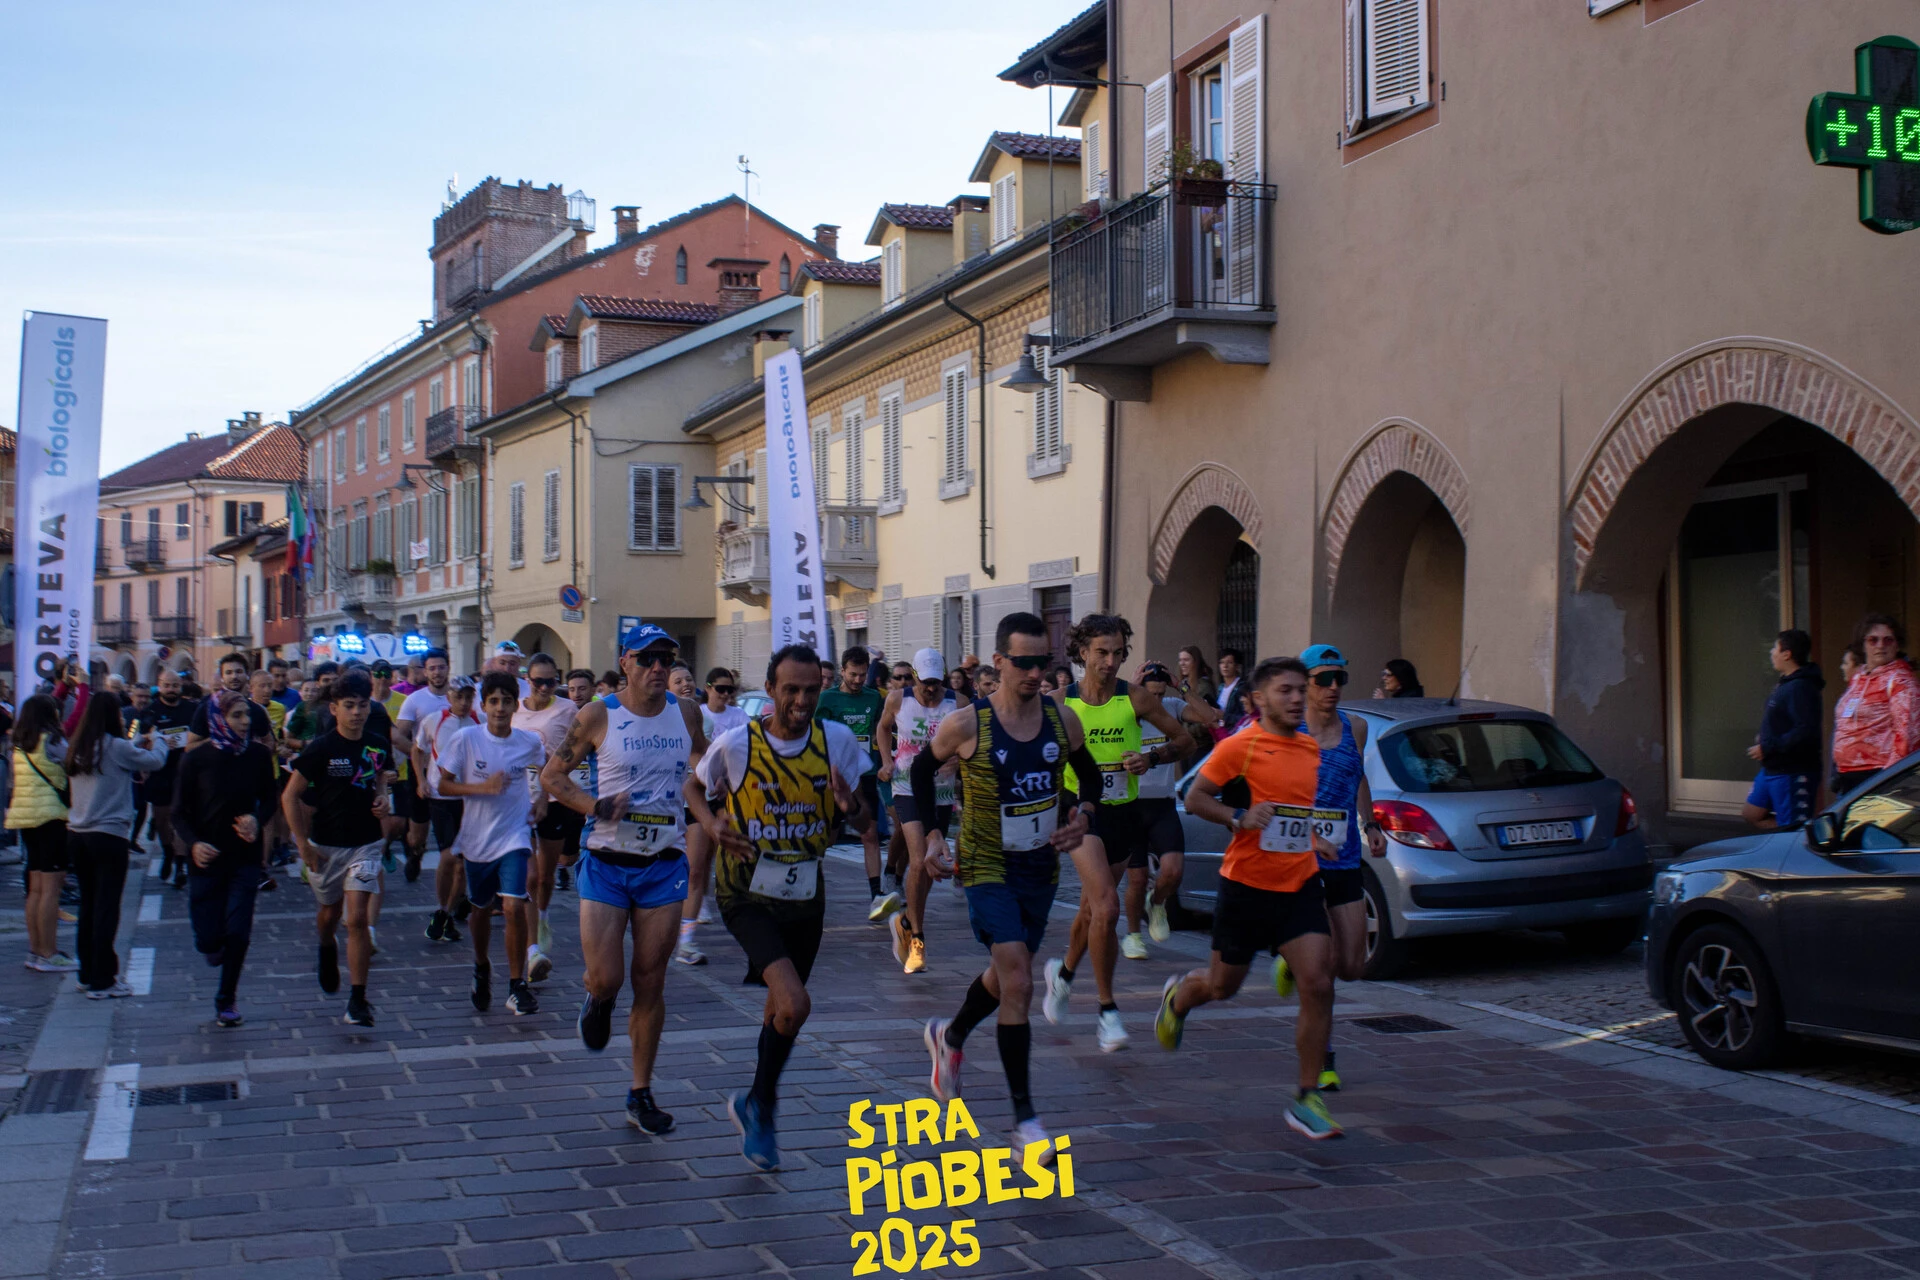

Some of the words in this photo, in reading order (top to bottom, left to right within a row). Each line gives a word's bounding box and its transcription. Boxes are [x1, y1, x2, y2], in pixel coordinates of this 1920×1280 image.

[42, 325, 78, 477] biologicals
[35, 513, 67, 682] ORTEVA
[1089, 728, 1124, 737] RUN
[1101, 736, 1124, 744] team
[636, 825, 659, 843] 31
[748, 817, 827, 841] Bairese
[1031, 816, 1040, 834] 1
[785, 867, 798, 884] 5
